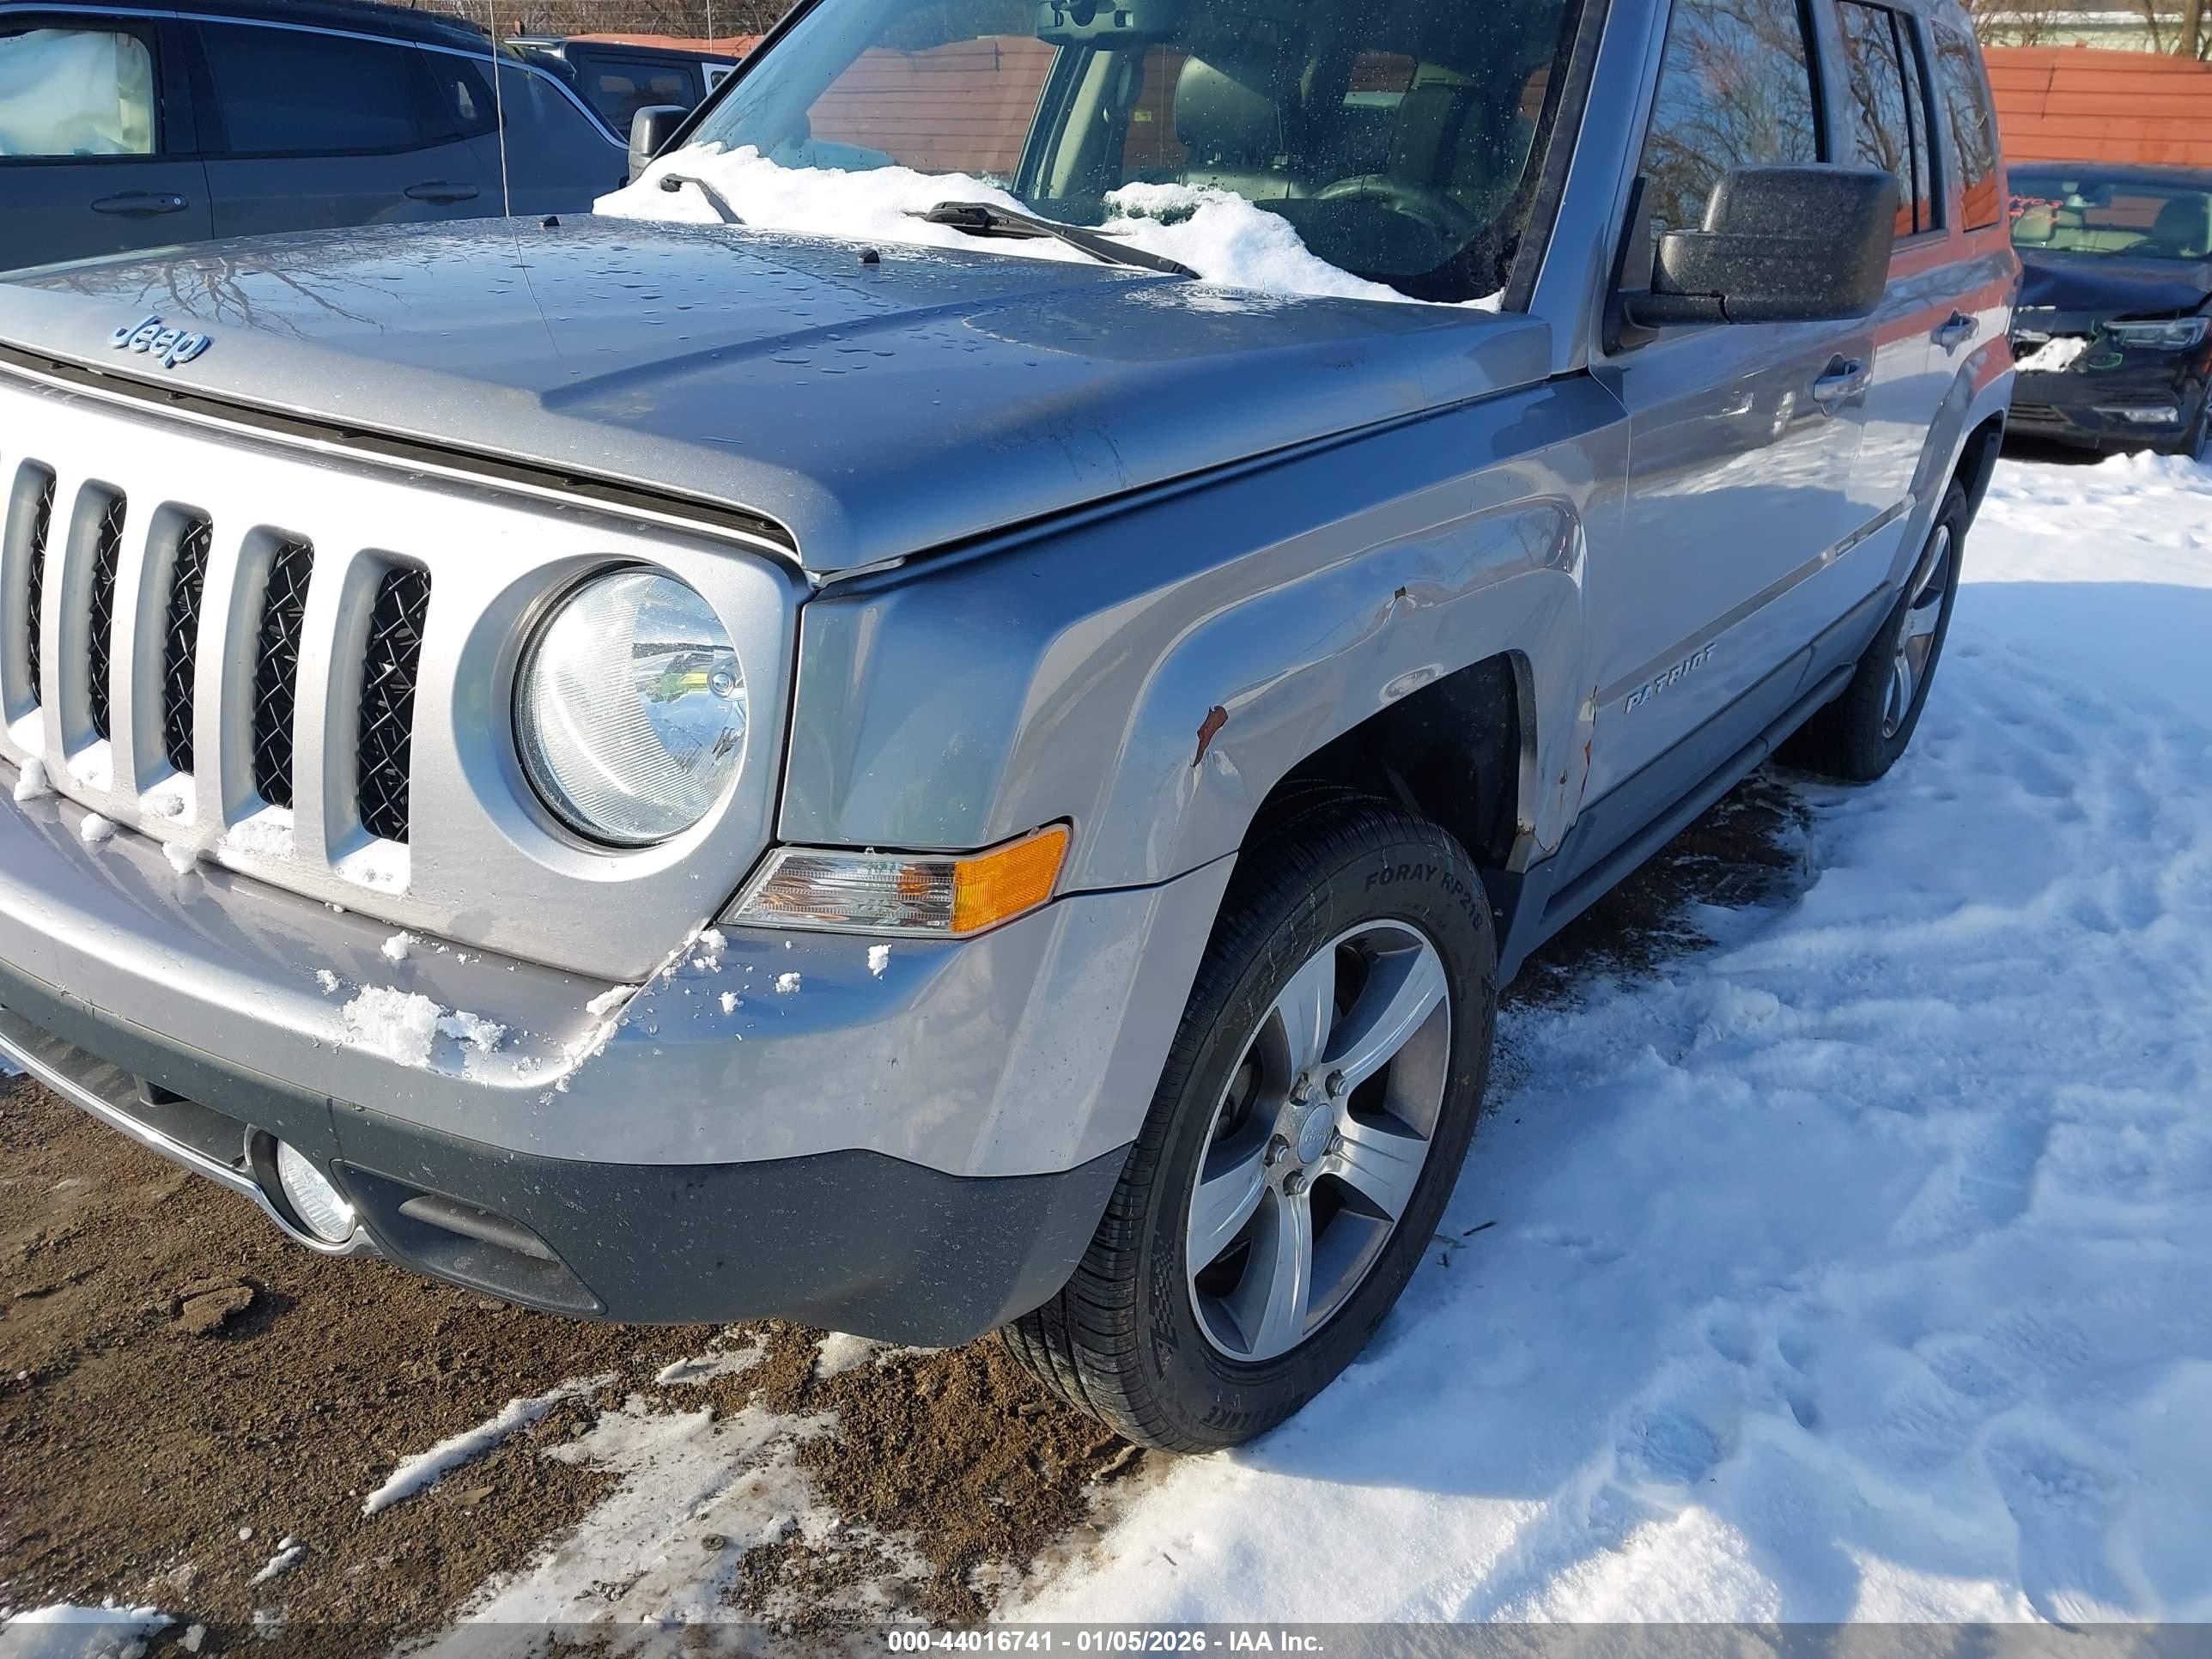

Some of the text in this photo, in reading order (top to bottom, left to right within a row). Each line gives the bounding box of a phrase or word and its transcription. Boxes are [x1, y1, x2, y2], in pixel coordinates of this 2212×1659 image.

[108, 314, 211, 369] Jeep
[1624, 642, 1717, 714] PATRIOT
[1364, 863, 1438, 893] FORAY
